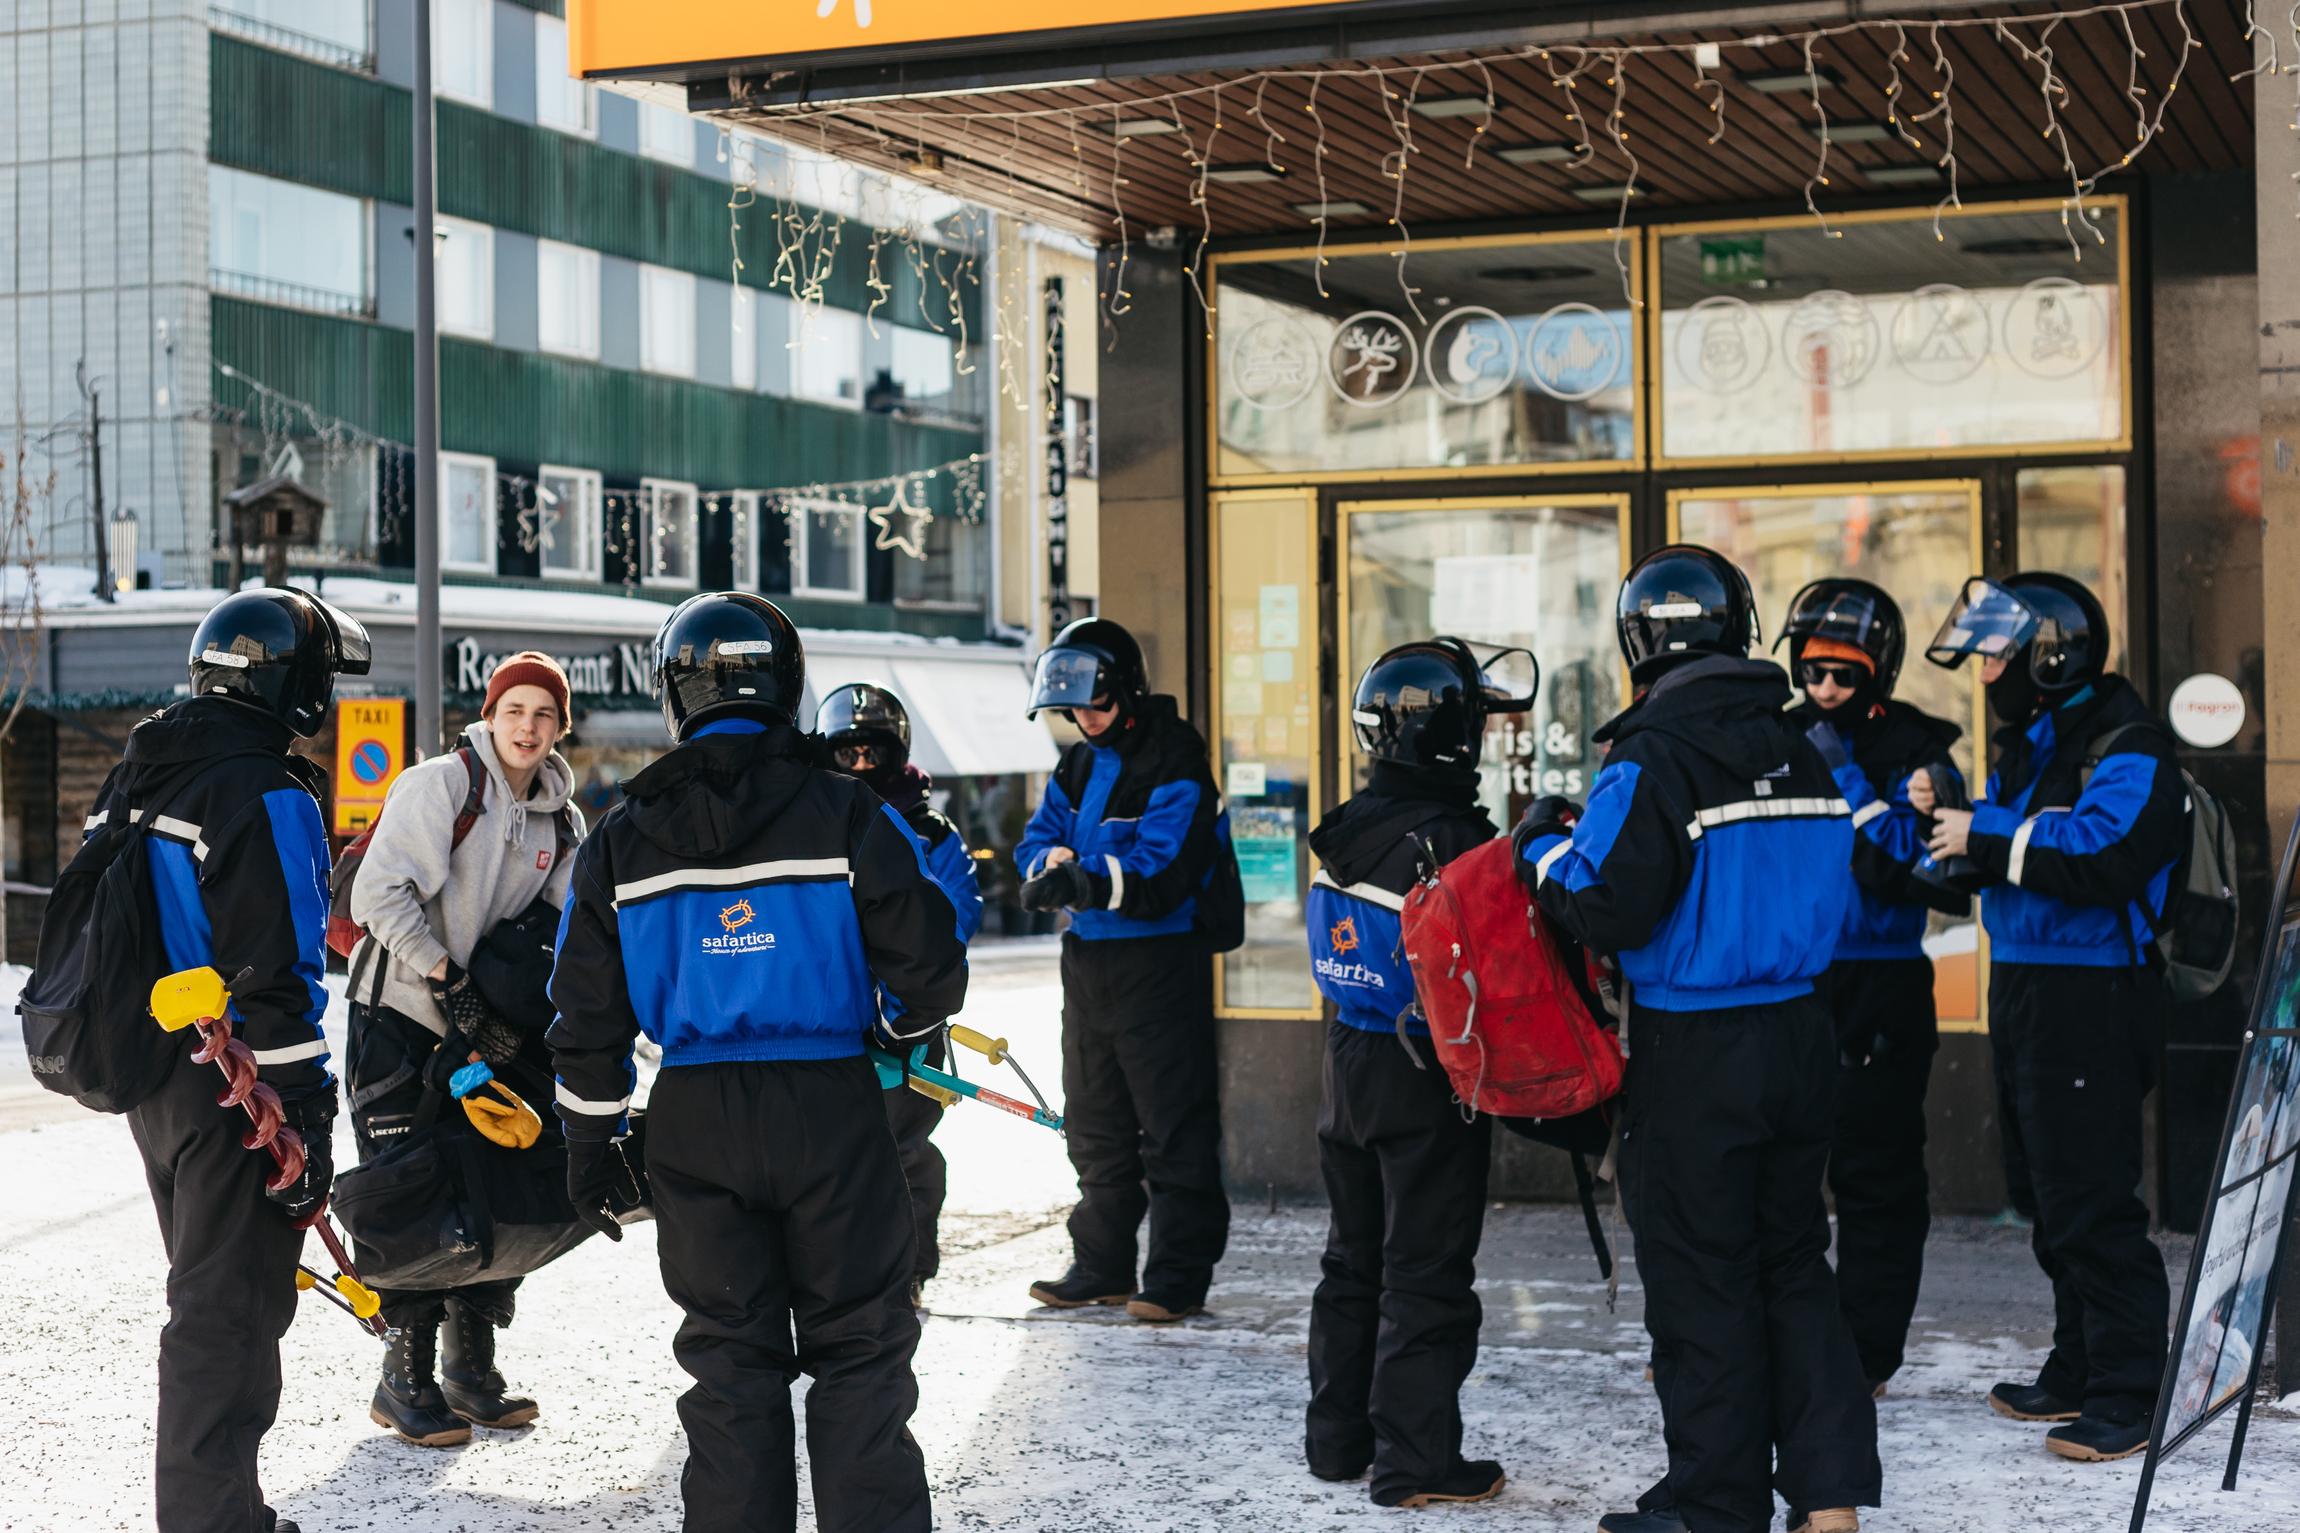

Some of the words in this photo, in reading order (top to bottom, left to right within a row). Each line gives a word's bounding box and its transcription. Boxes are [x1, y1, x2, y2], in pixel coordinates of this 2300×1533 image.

[618, 643, 656, 695] Ni
[354, 708, 390, 725] TAXI
[1544, 721, 1575, 755] &
[702, 932, 776, 948] safartica
[1315, 957, 1385, 988] safartica
[29, 1054, 65, 1074] esse
[375, 1126, 411, 1136] SCOTT
